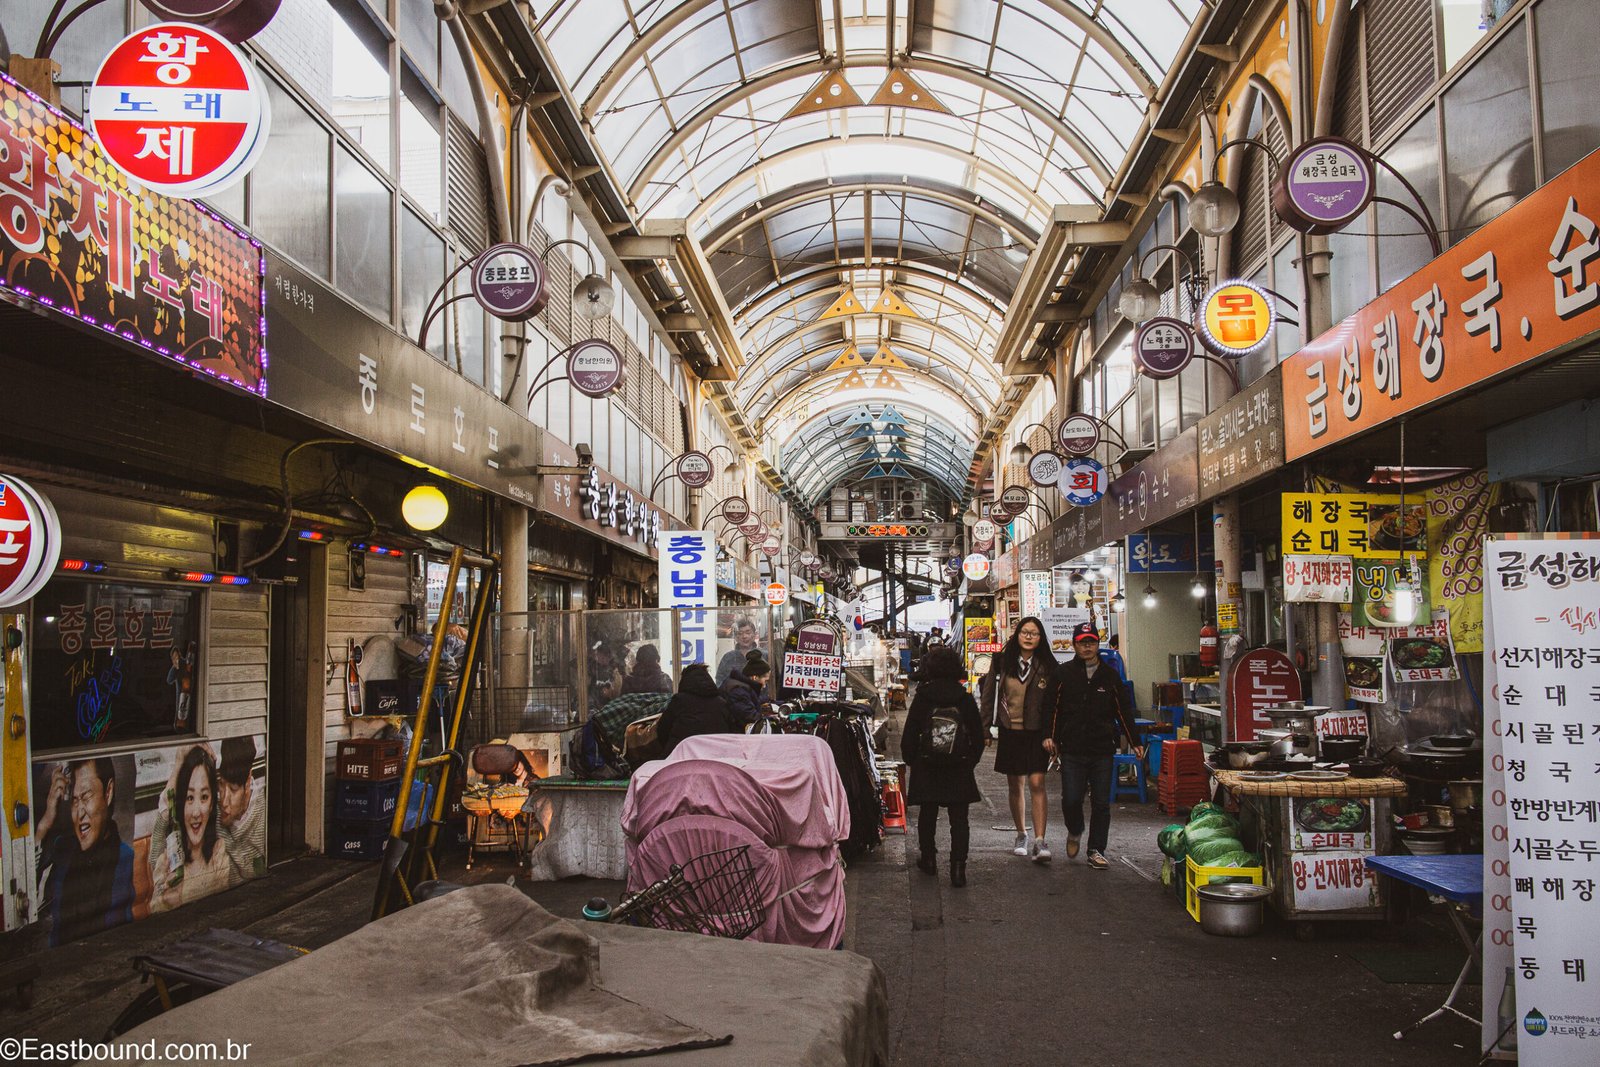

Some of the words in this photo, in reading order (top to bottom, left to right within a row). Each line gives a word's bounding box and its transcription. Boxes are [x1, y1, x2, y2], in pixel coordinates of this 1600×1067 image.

[138, 31, 209, 85] 황
[113, 92, 221, 119] 노래
[135, 126, 196, 175] 제
[1315, 153, 1337, 166] 금성
[1302, 165, 1328, 178] 해장국
[1331, 164, 1357, 177] 순대국
[484, 266, 530, 281] 종로호프
[143, 247, 225, 342] 노래
[359, 353, 499, 470] 종로호프
[1068, 470, 1099, 495] 회
[1291, 500, 1369, 524] 해장국
[1290, 529, 1369, 553] 순대국
[58, 603, 174, 655] 종로호프
[785, 664, 840, 679] 가죽잠바염색
[786, 654, 840, 668] 가죽잠바수선
[1249, 659, 1290, 675] 폭스
[347, 764, 369, 774] HITE
[1311, 833, 1355, 848] 순대국
[1516, 917, 1538, 940] 묵
[1550, 1025, 1588, 1039] 부드러운
